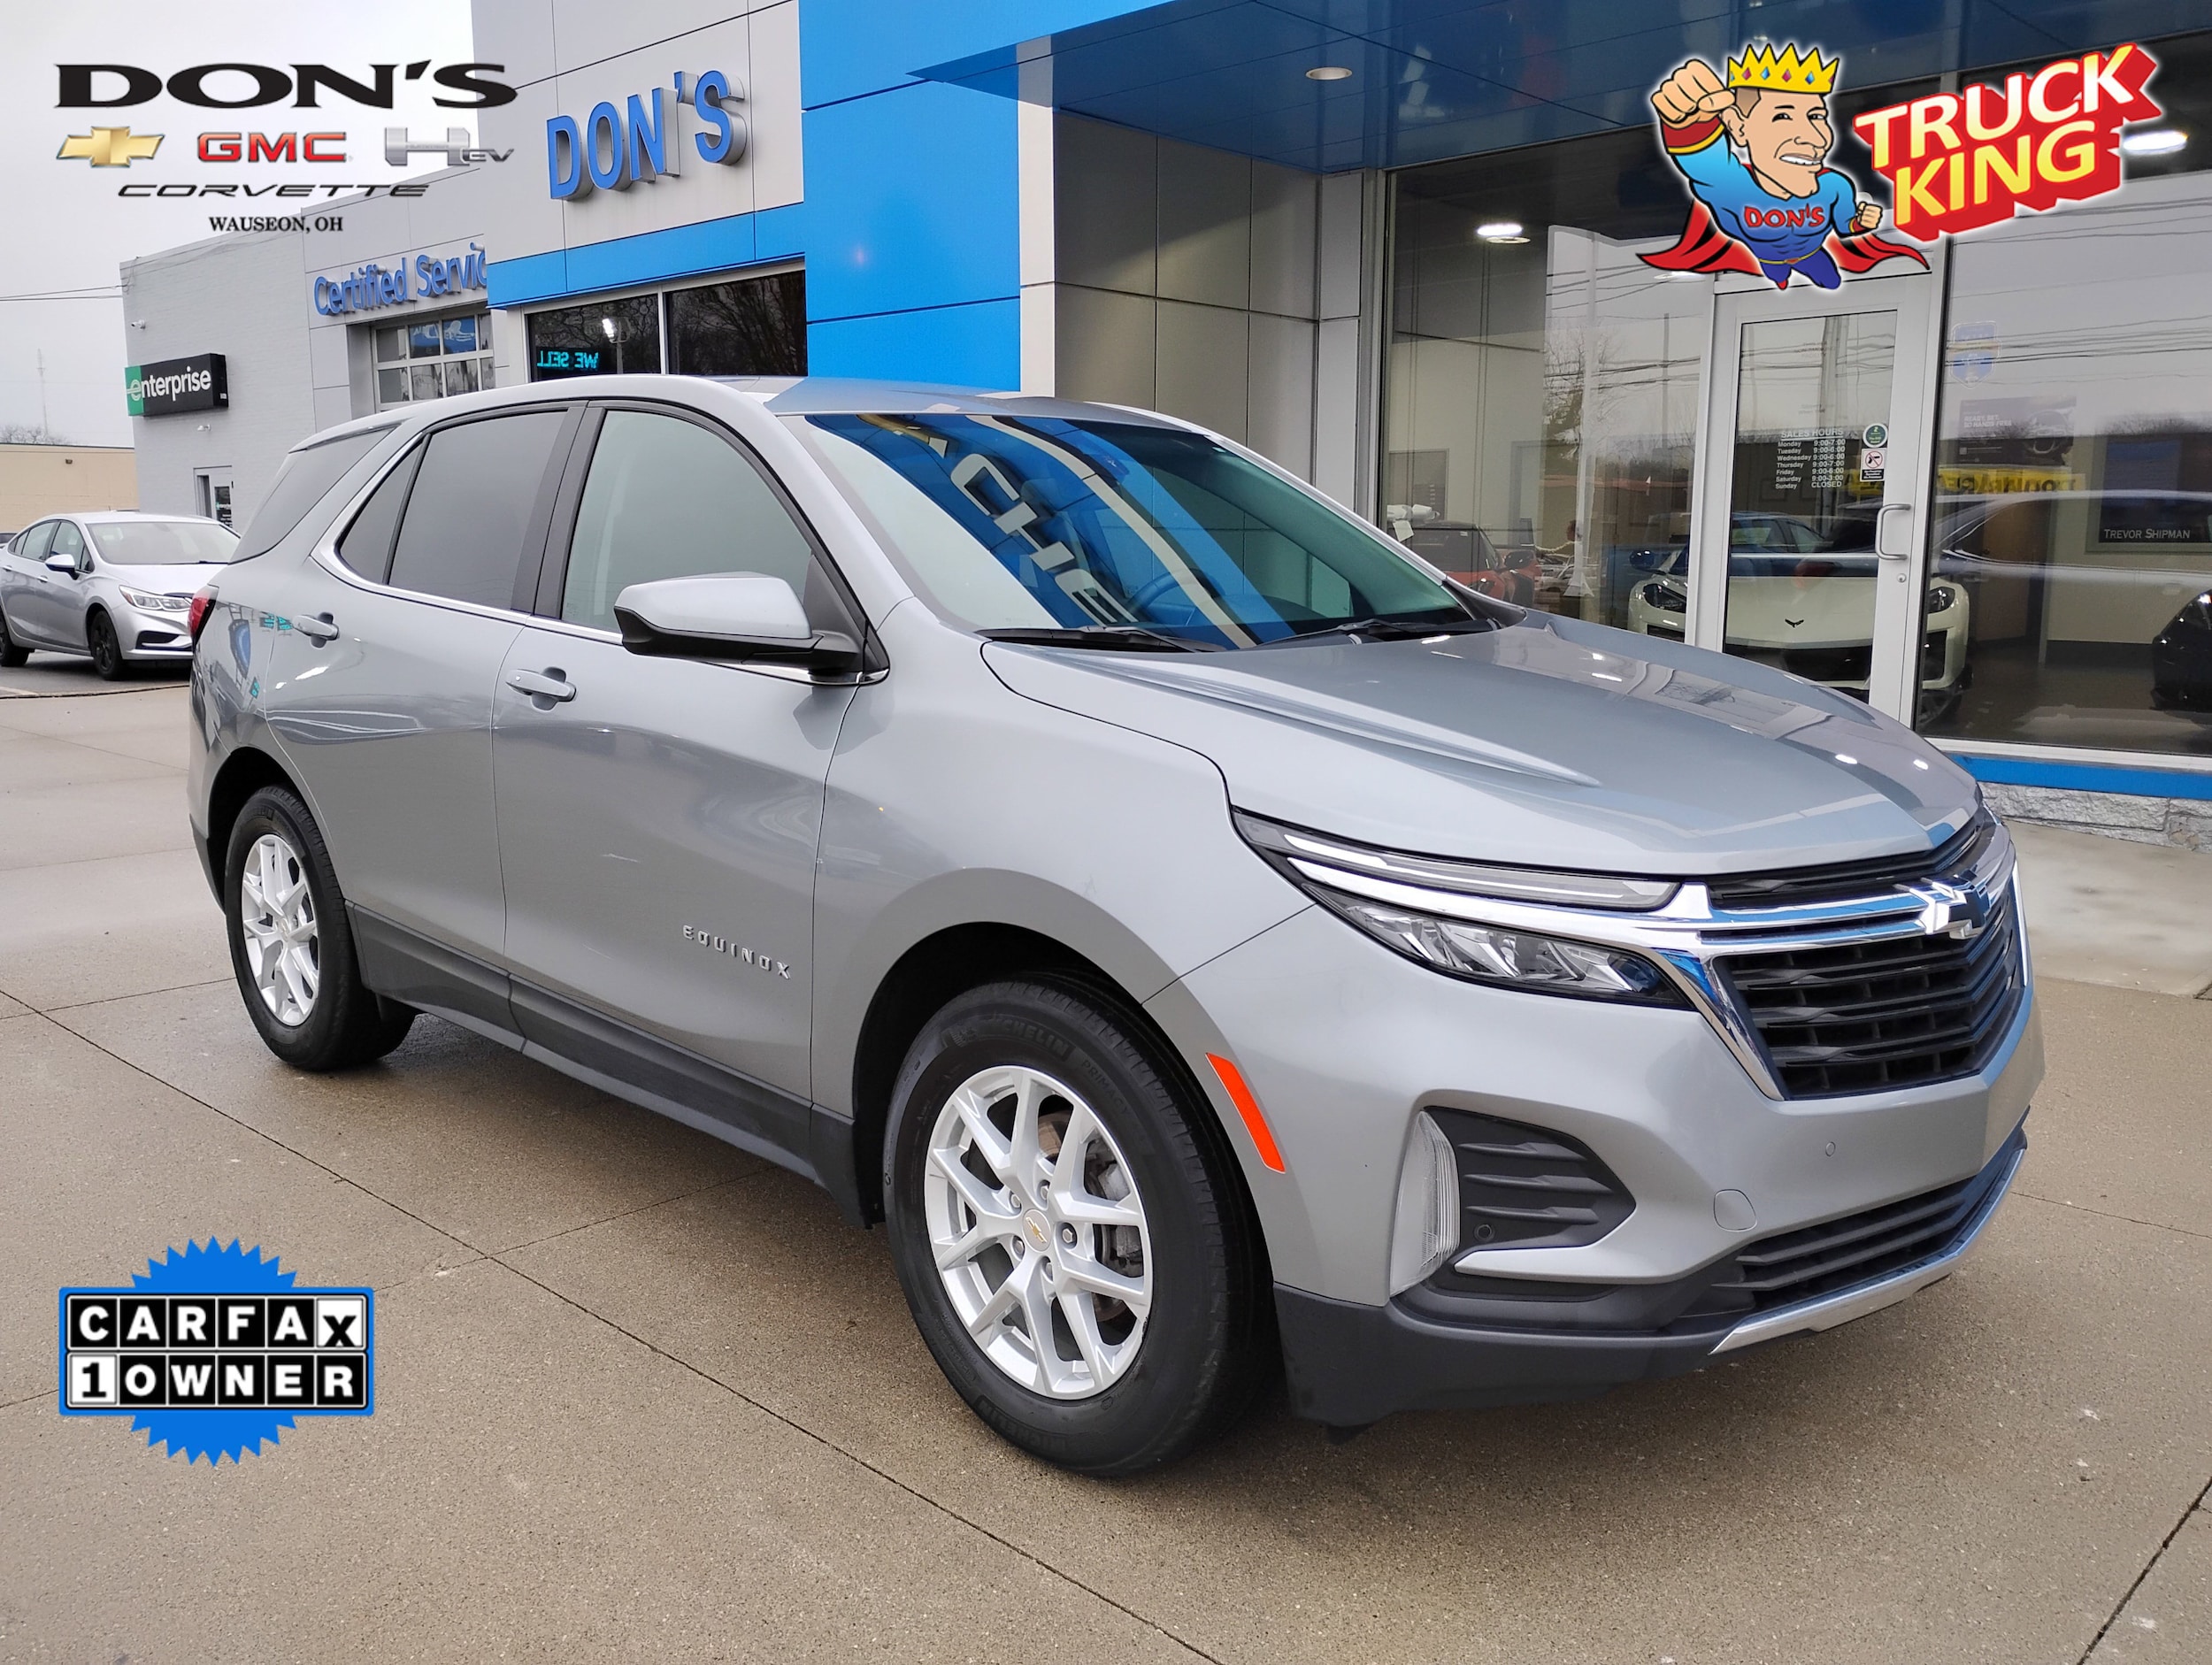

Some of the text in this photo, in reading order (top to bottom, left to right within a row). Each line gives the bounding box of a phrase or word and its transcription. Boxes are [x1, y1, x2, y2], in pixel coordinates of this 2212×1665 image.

[546, 70, 738, 201] DON'S
[314, 257, 409, 316] Certified
[127, 365, 211, 402] enterprise
[1780, 427, 1844, 439] SALES HOURS
[2104, 527, 2191, 539] TREVOR SHIPMAN
[682, 925, 791, 980] EQUINOX
